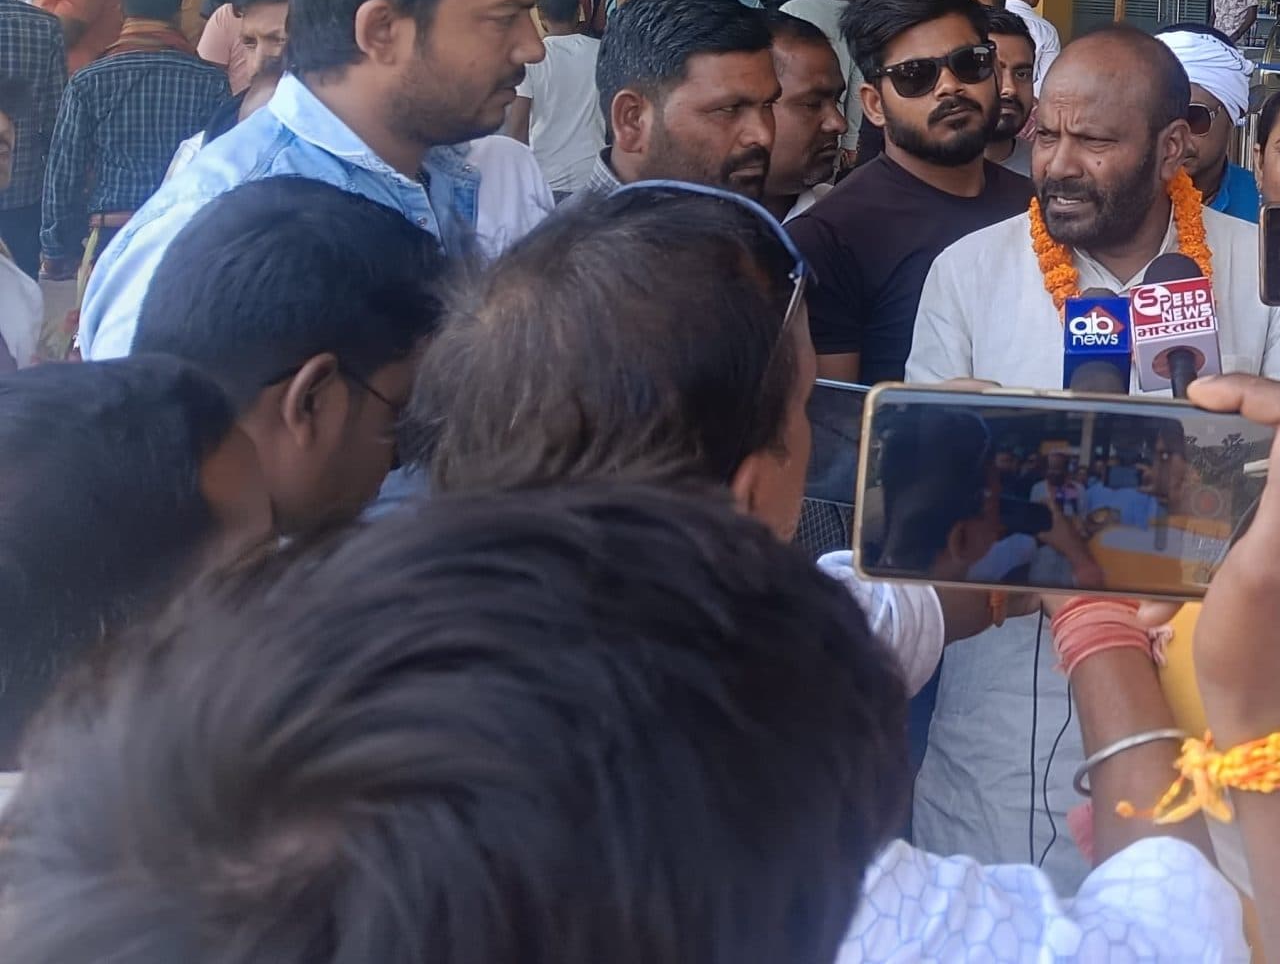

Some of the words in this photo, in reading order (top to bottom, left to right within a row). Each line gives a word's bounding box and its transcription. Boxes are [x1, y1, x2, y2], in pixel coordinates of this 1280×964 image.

[1137, 289, 1207, 312] SPEED
[1069, 312, 1113, 334] ab
[1161, 303, 1212, 323] NEWS
[1137, 317, 1211, 337] भारतवर्ष
[1073, 333, 1118, 345] news
